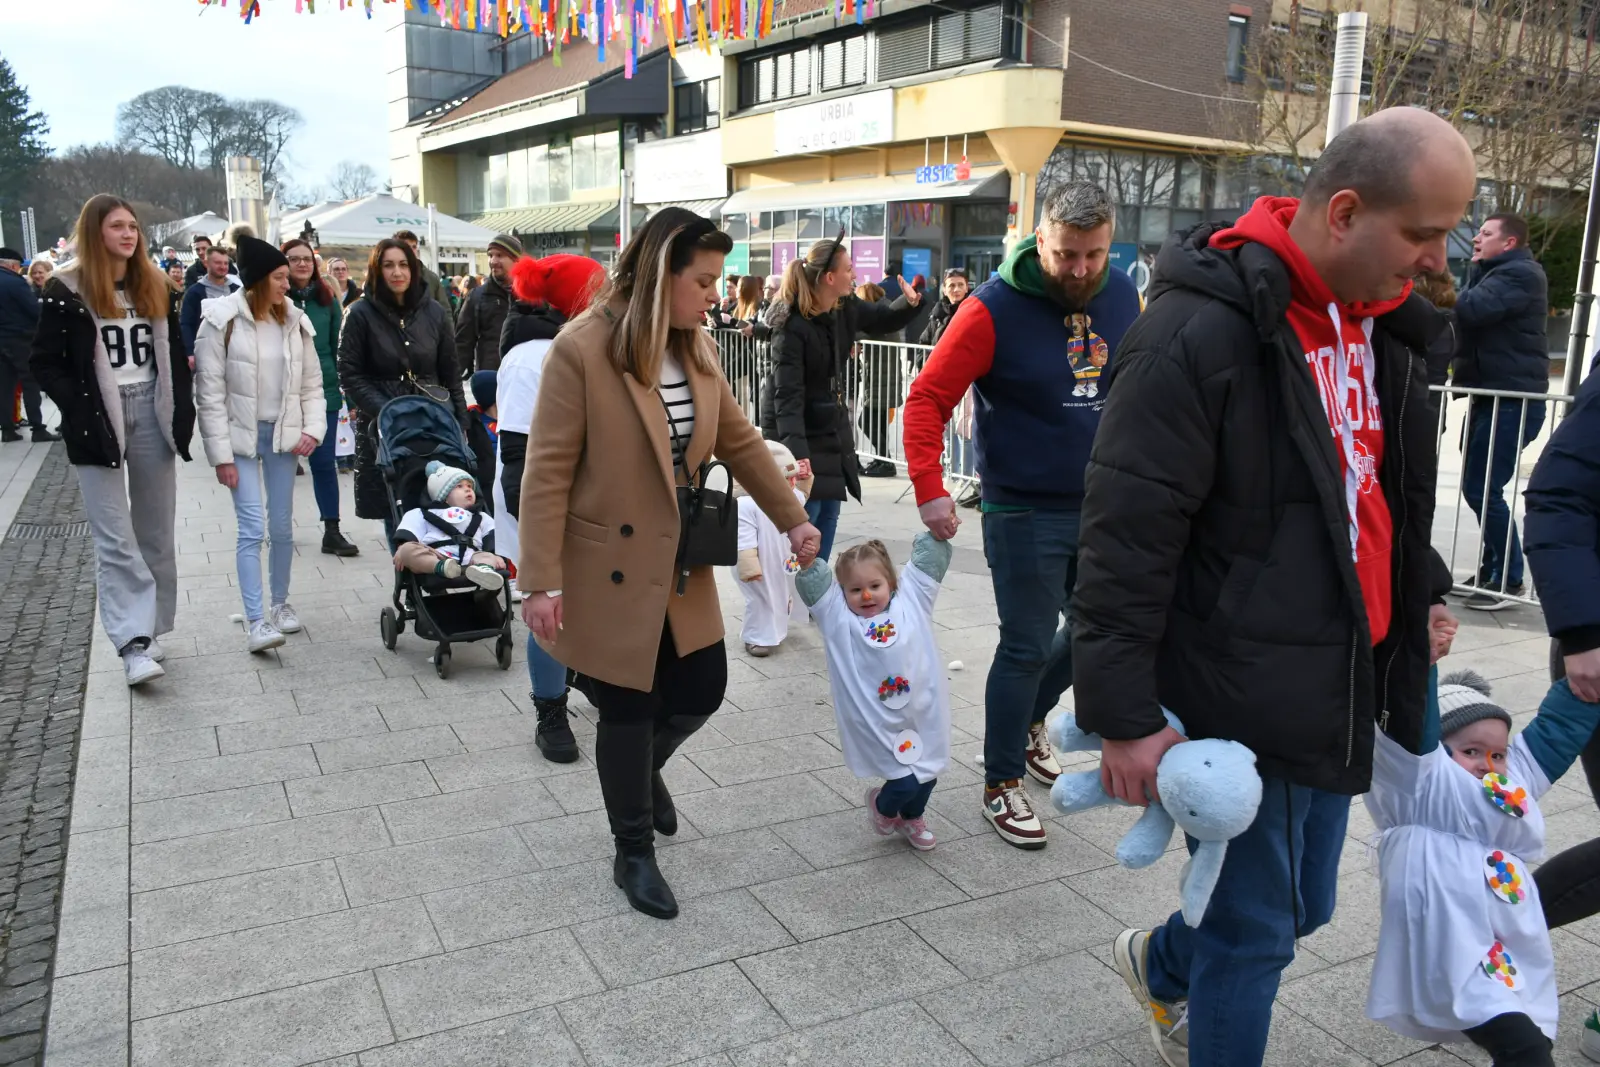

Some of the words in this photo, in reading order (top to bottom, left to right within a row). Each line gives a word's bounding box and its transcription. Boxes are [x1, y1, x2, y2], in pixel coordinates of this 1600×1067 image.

[820, 101, 855, 122] URBIA
[861, 121, 879, 139] 25
[915, 164, 956, 184] ERSTE
[100, 323, 153, 368] 86
